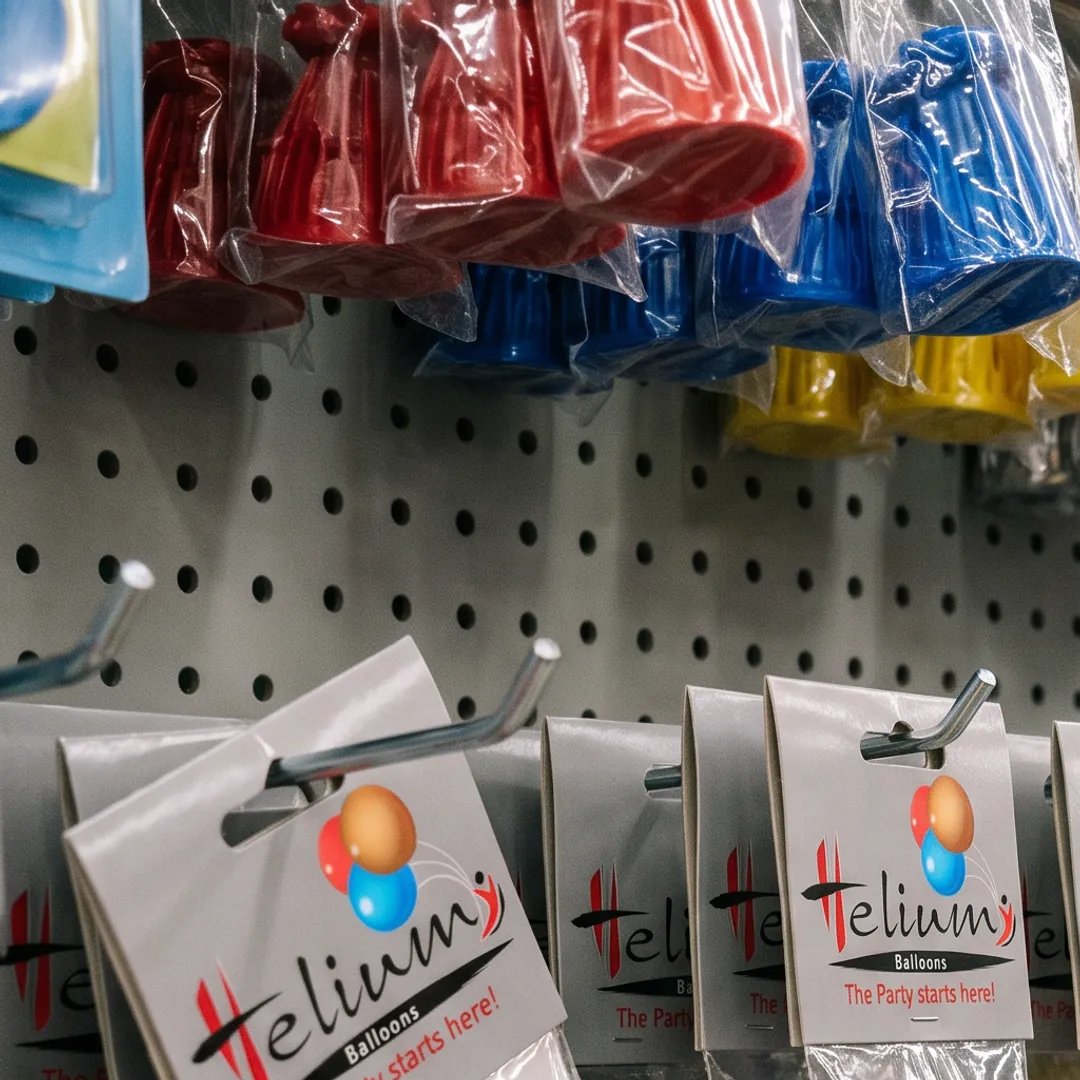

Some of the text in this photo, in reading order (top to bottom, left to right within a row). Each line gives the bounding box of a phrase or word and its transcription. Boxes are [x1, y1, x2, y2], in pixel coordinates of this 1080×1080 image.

[895, 953, 948, 971] Balloons
[750, 992, 778, 1015] The
[844, 982, 996, 1010] The Party starts here!
[443, 986, 500, 1040] here!
[616, 1007, 648, 1030] The
[344, 1003, 421, 1066] Balloons
